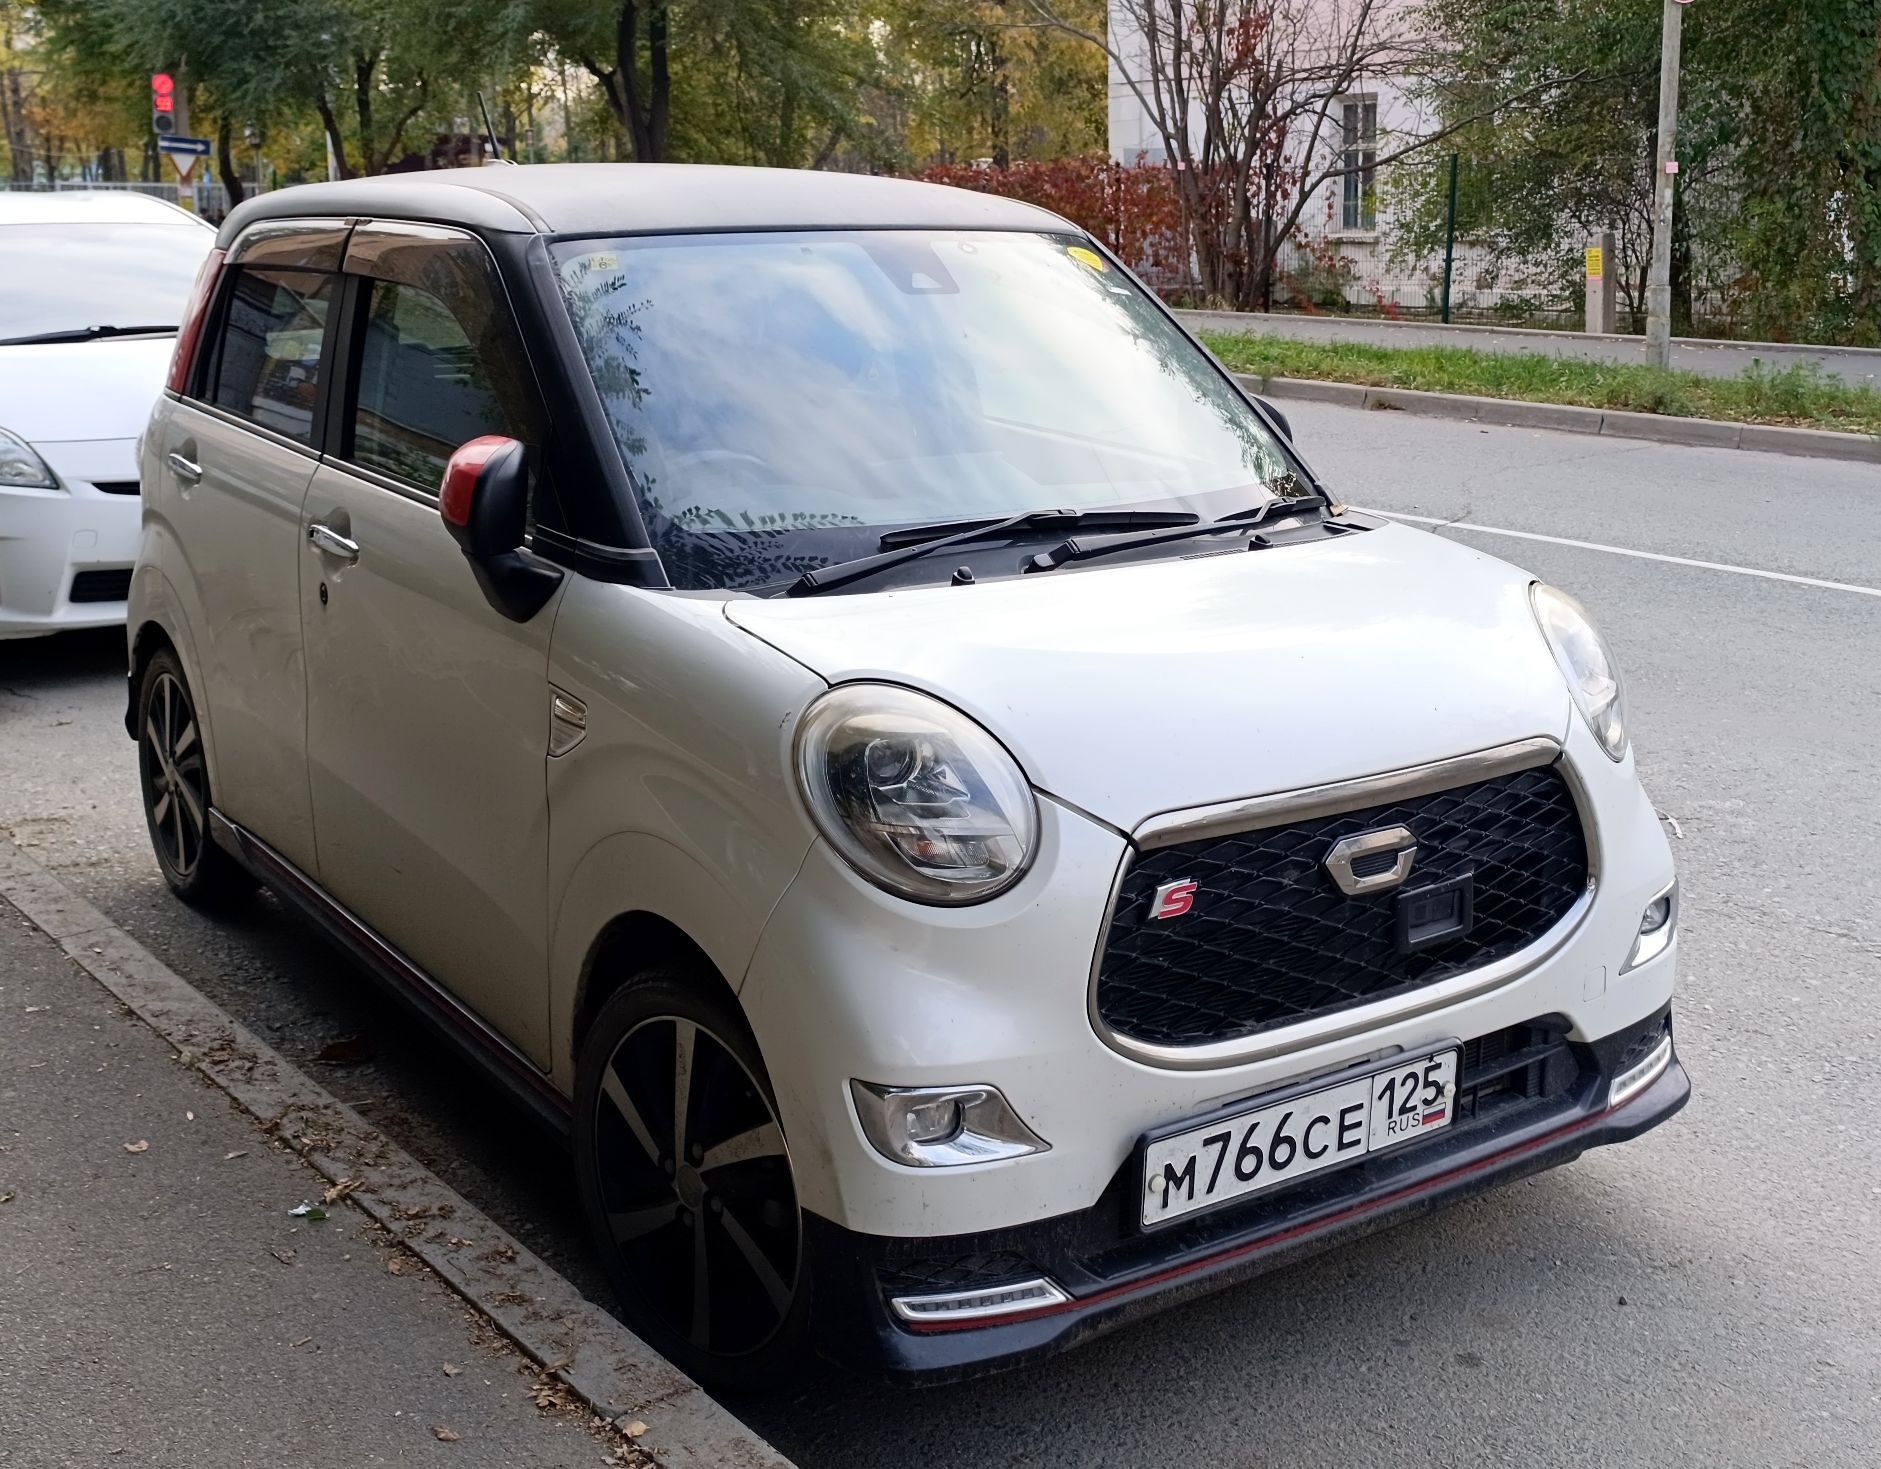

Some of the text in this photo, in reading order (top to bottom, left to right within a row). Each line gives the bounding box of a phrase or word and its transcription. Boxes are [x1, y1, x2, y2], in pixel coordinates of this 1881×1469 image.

[1157, 881, 1198, 920] S
[1161, 1062, 1443, 1209] M766CE 125
[1386, 1112, 1421, 1138] RUS
